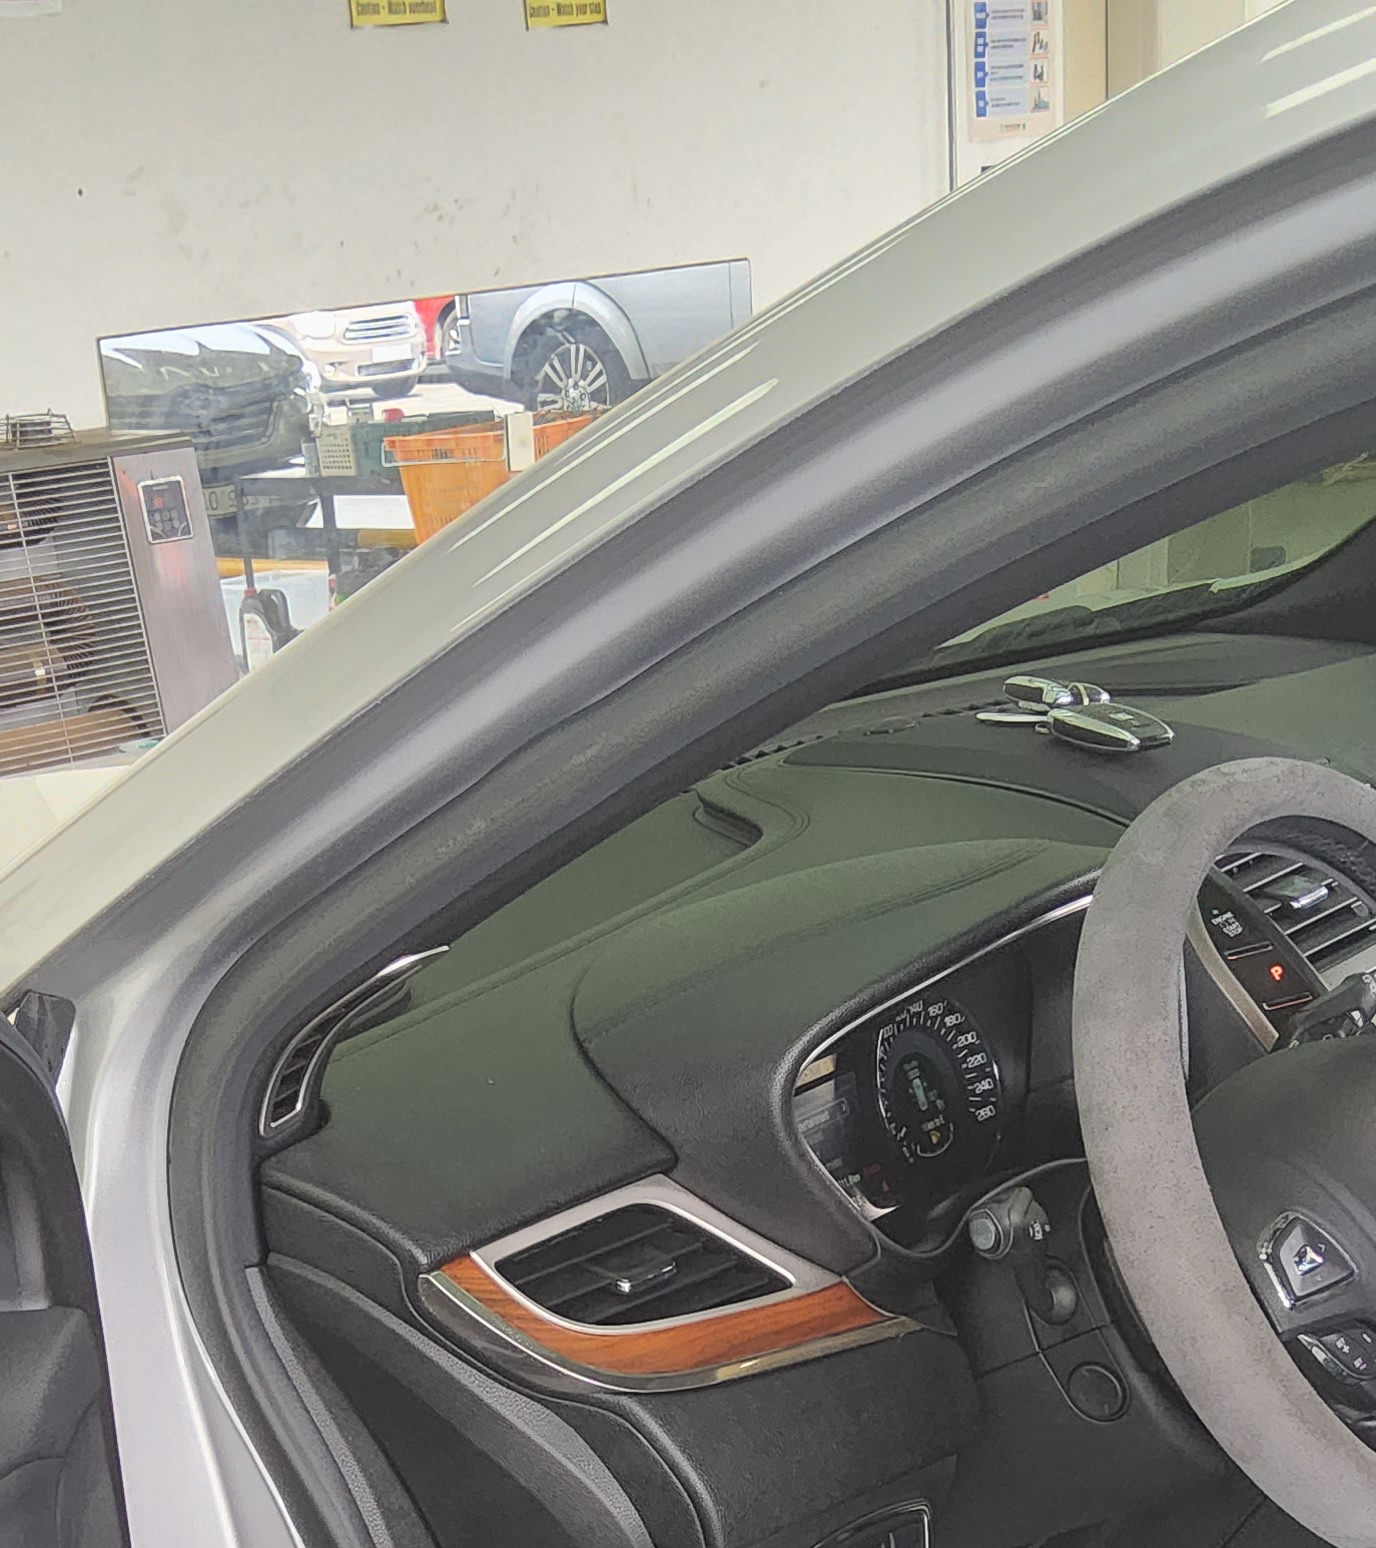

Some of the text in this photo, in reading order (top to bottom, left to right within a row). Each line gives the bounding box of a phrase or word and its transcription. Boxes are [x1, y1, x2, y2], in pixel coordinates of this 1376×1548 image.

[1270, 965, 1283, 981] P
[927, 1002, 944, 1017] 160
[944, 1012, 961, 1027] 180
[957, 1031, 977, 1048] 200
[966, 1052, 987, 1069] 220
[973, 1077, 994, 1095] 240
[975, 1104, 996, 1122] 260
